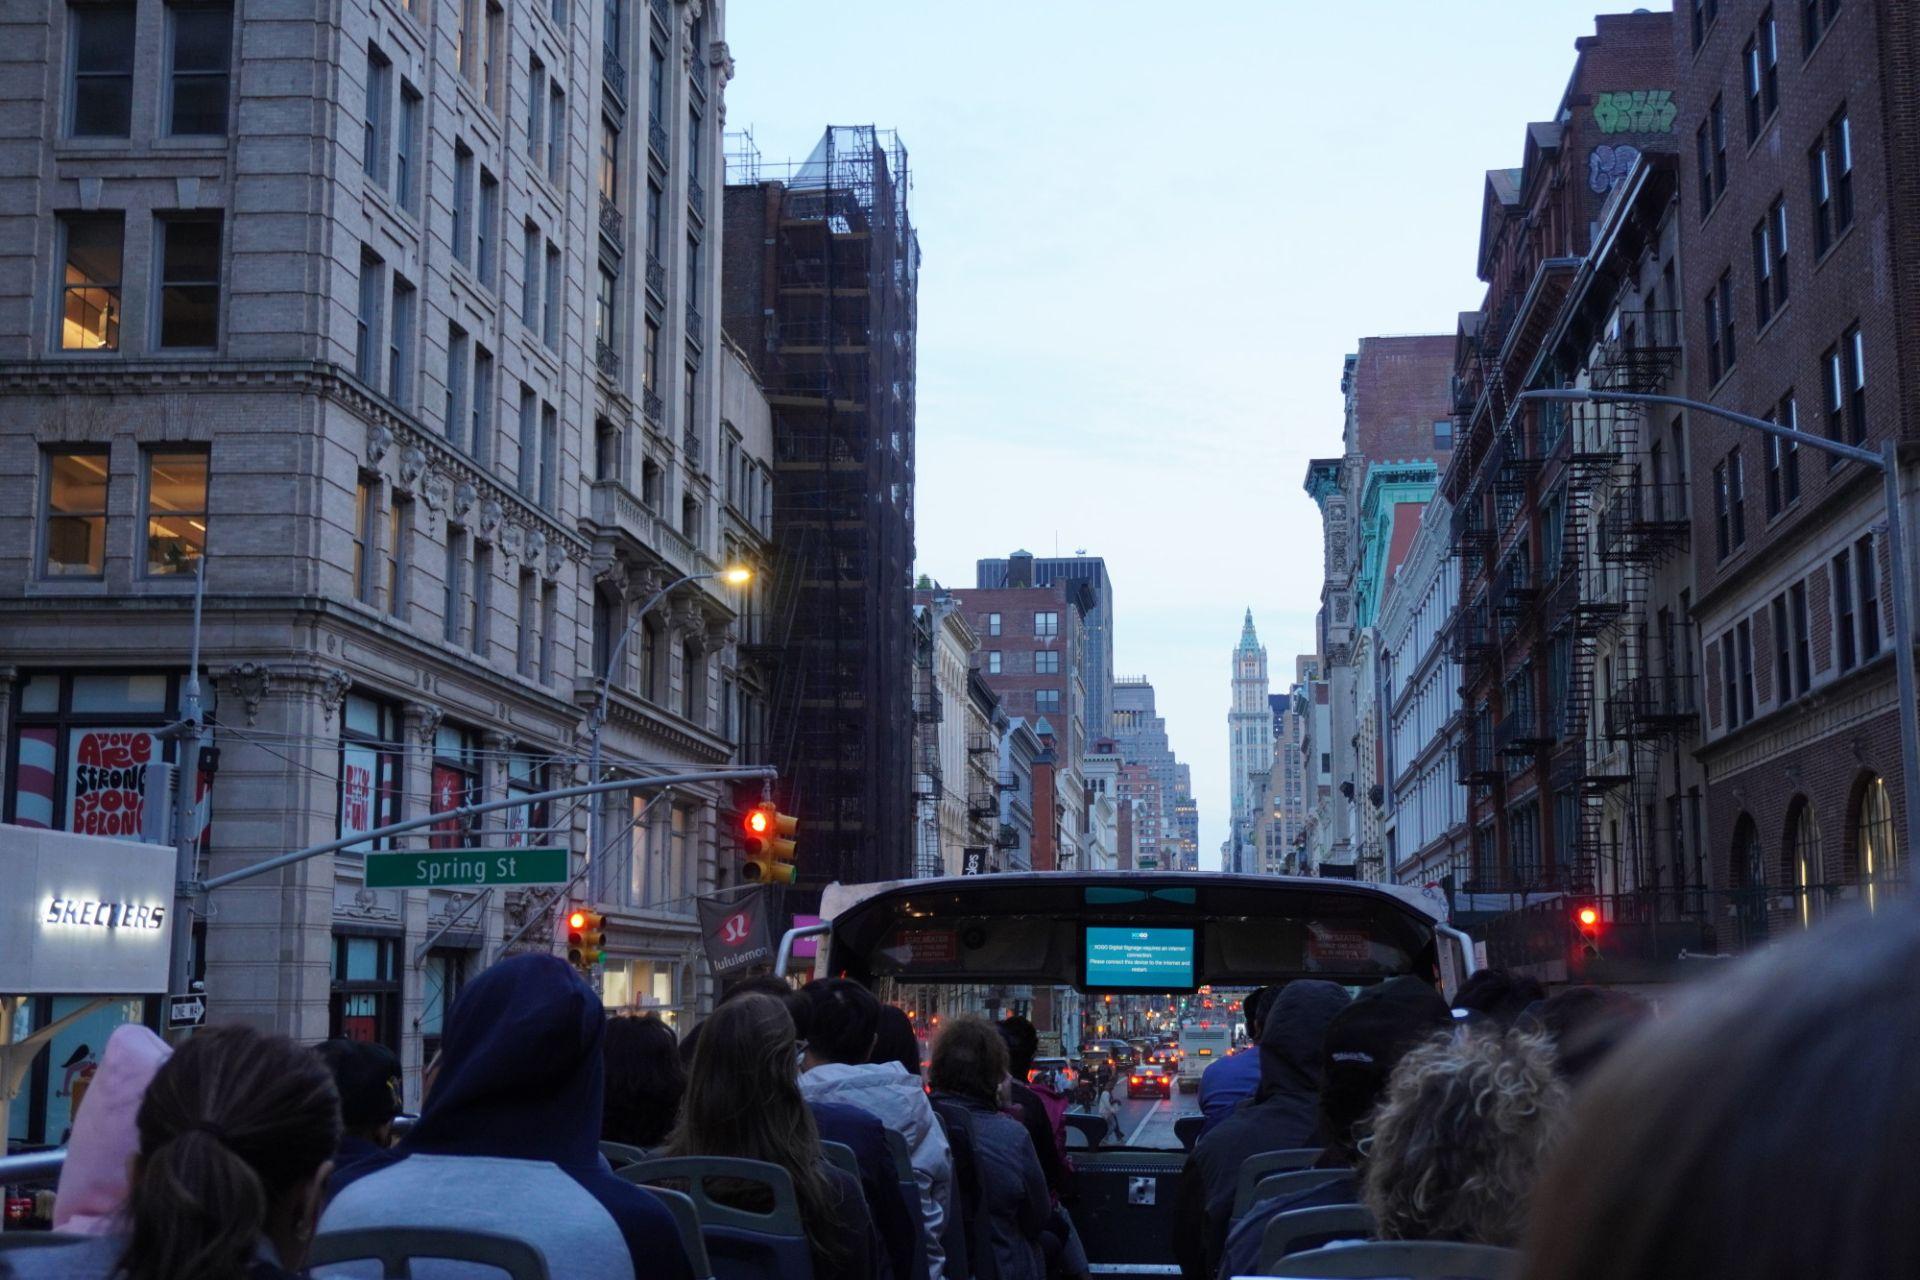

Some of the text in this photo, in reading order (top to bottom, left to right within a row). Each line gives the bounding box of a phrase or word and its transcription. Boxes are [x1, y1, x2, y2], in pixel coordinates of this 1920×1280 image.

[416, 857, 517, 884] Spring St
[713, 946, 768, 971] lululemon
